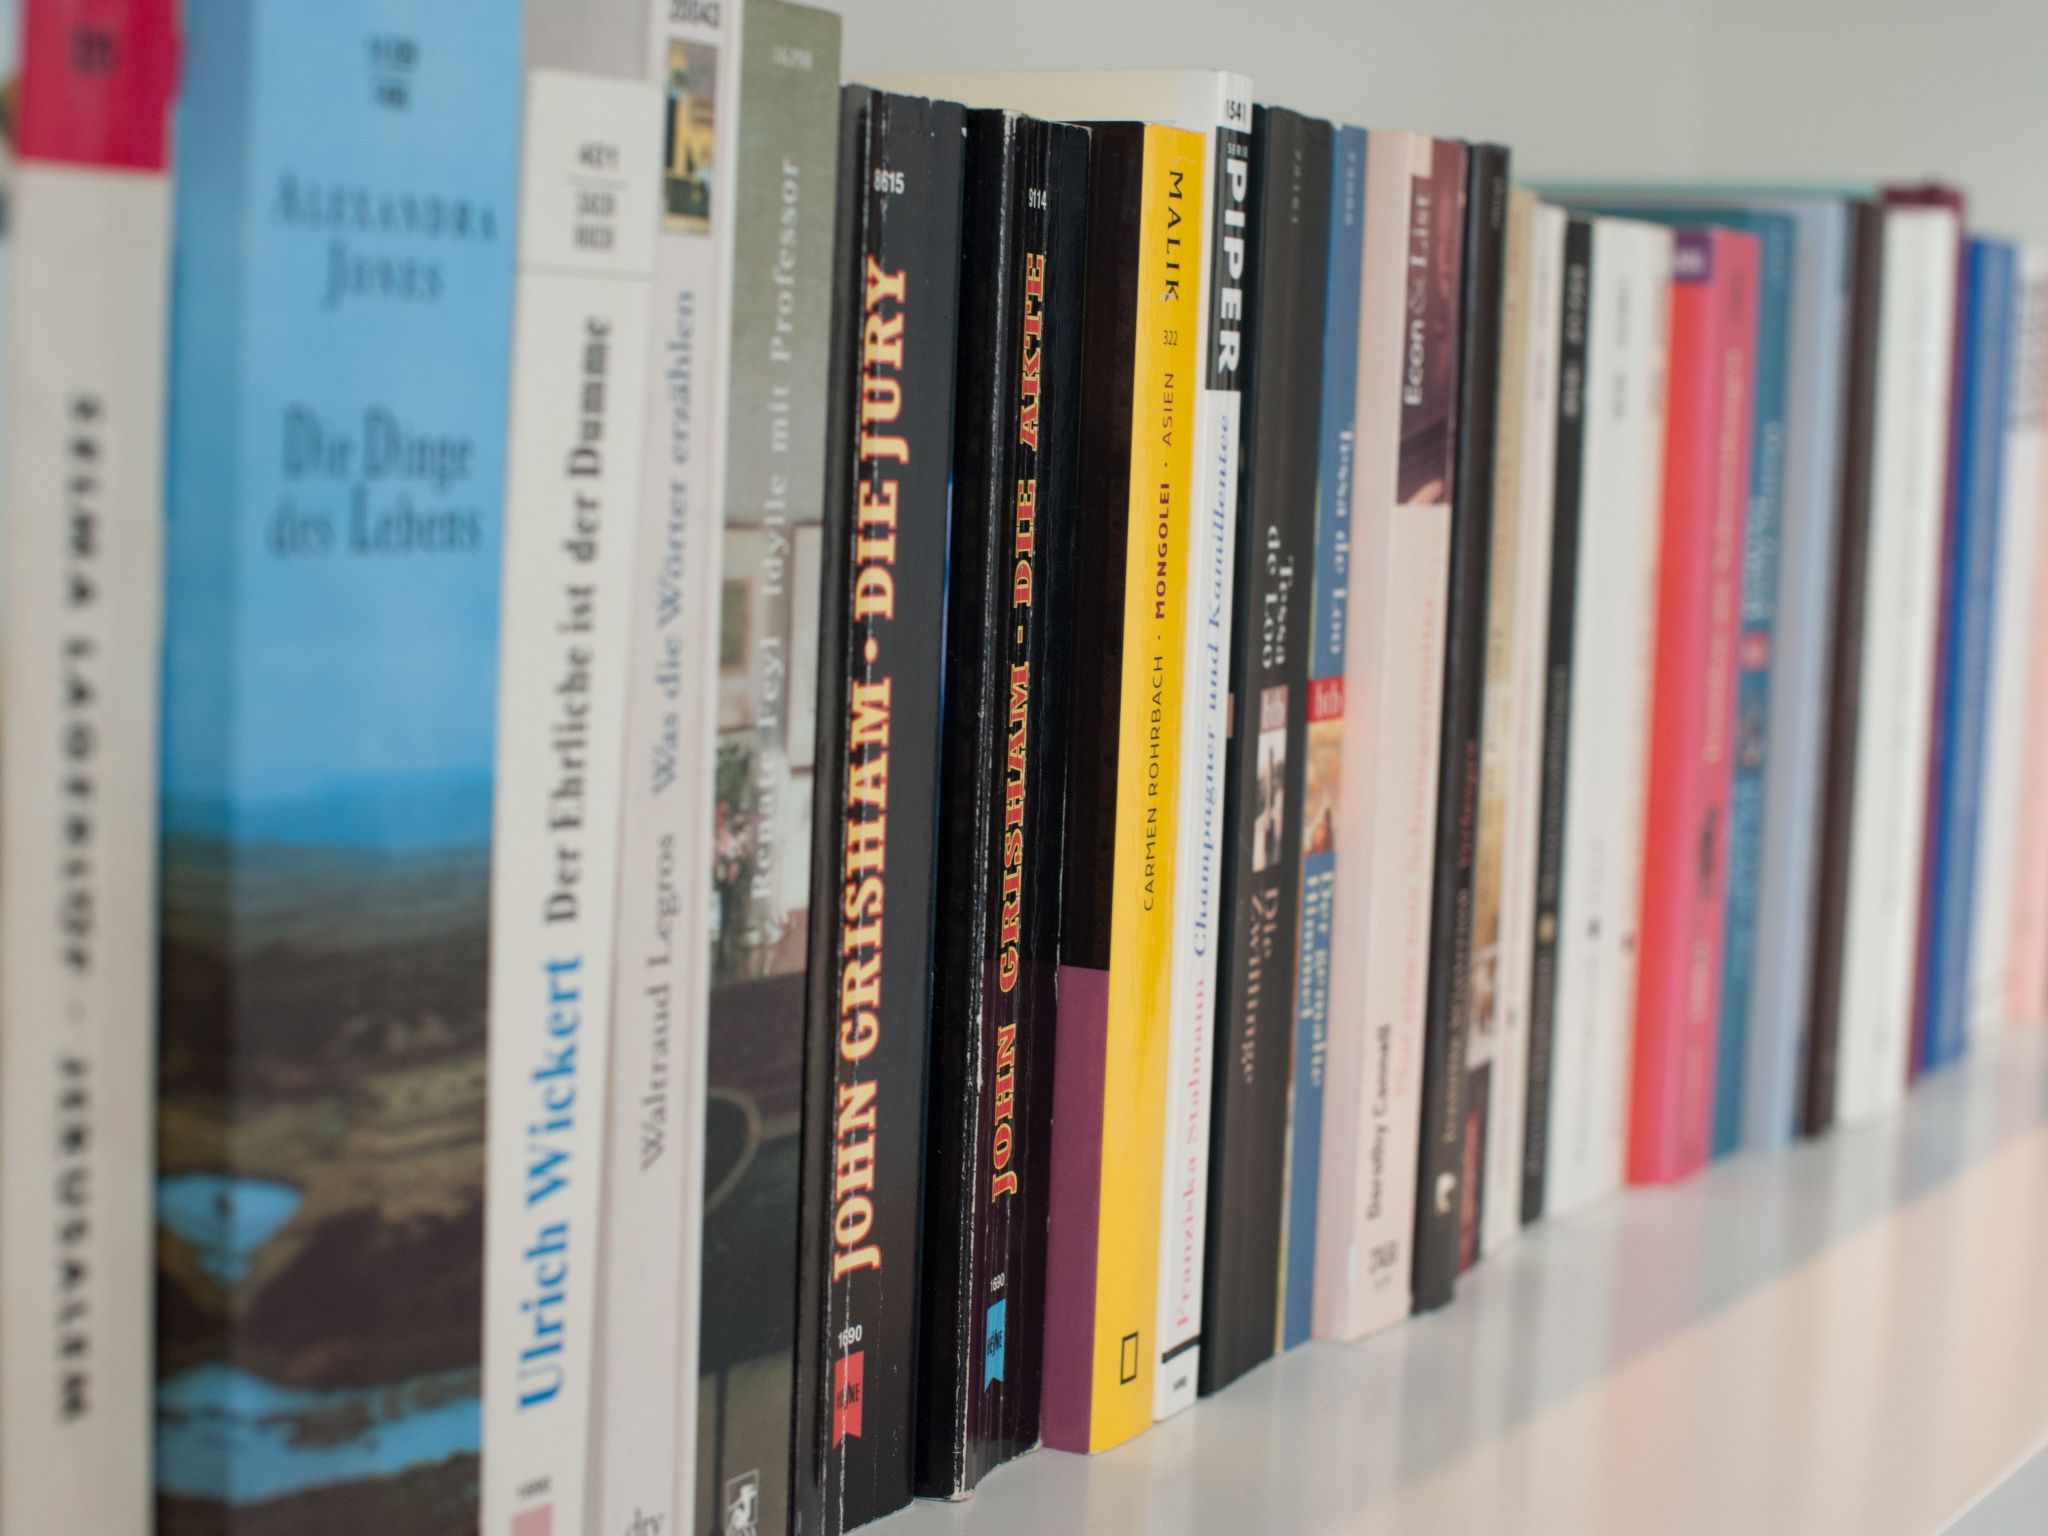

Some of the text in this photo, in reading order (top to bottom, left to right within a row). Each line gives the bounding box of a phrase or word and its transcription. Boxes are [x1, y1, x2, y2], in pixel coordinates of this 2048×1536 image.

[1225, 99, 1247, 123] 1541
[873, 168, 905, 195] 8615
[1028, 188, 1048, 210] 9114
[1163, 169, 1185, 303] MALIK
[768, 157, 803, 363] Professor
[1218, 158, 1249, 374] PIPER
[1162, 329, 1179, 347] 322
[1404, 320, 1427, 406] Econ
[281, 404, 474, 494] Die Dinge
[768, 384, 793, 452] mit
[267, 487, 482, 559] des Lebens
[651, 290, 695, 796] Was die Wörter erzählen
[760, 476, 793, 595] Idylle
[1266, 525, 1282, 576] de
[543, 318, 612, 925] Der Ehrliche ist der Dumme
[1143, 372, 1175, 912] CARMEN ROHRBACH MONGOLEI ASIEN
[1275, 555, 1294, 665] Tessa
[991, 252, 1046, 1204] JOHN GRISHAM DIE AKTE
[1194, 415, 1230, 958] Champagner und Kamillentee
[833, 255, 909, 1285] JOHN GRISHAM DIE JURY
[1240, 895, 1265, 1085] Zwillinge
[1262, 887, 1280, 959] Die
[637, 833, 681, 1171] Waltraud Legros
[523, 955, 584, 1209] Wickert
[1176, 978, 1206, 1327] Franziska Stalmann
[517, 1220, 569, 1413] Ulrich
[838, 1325, 862, 1349] 1690
